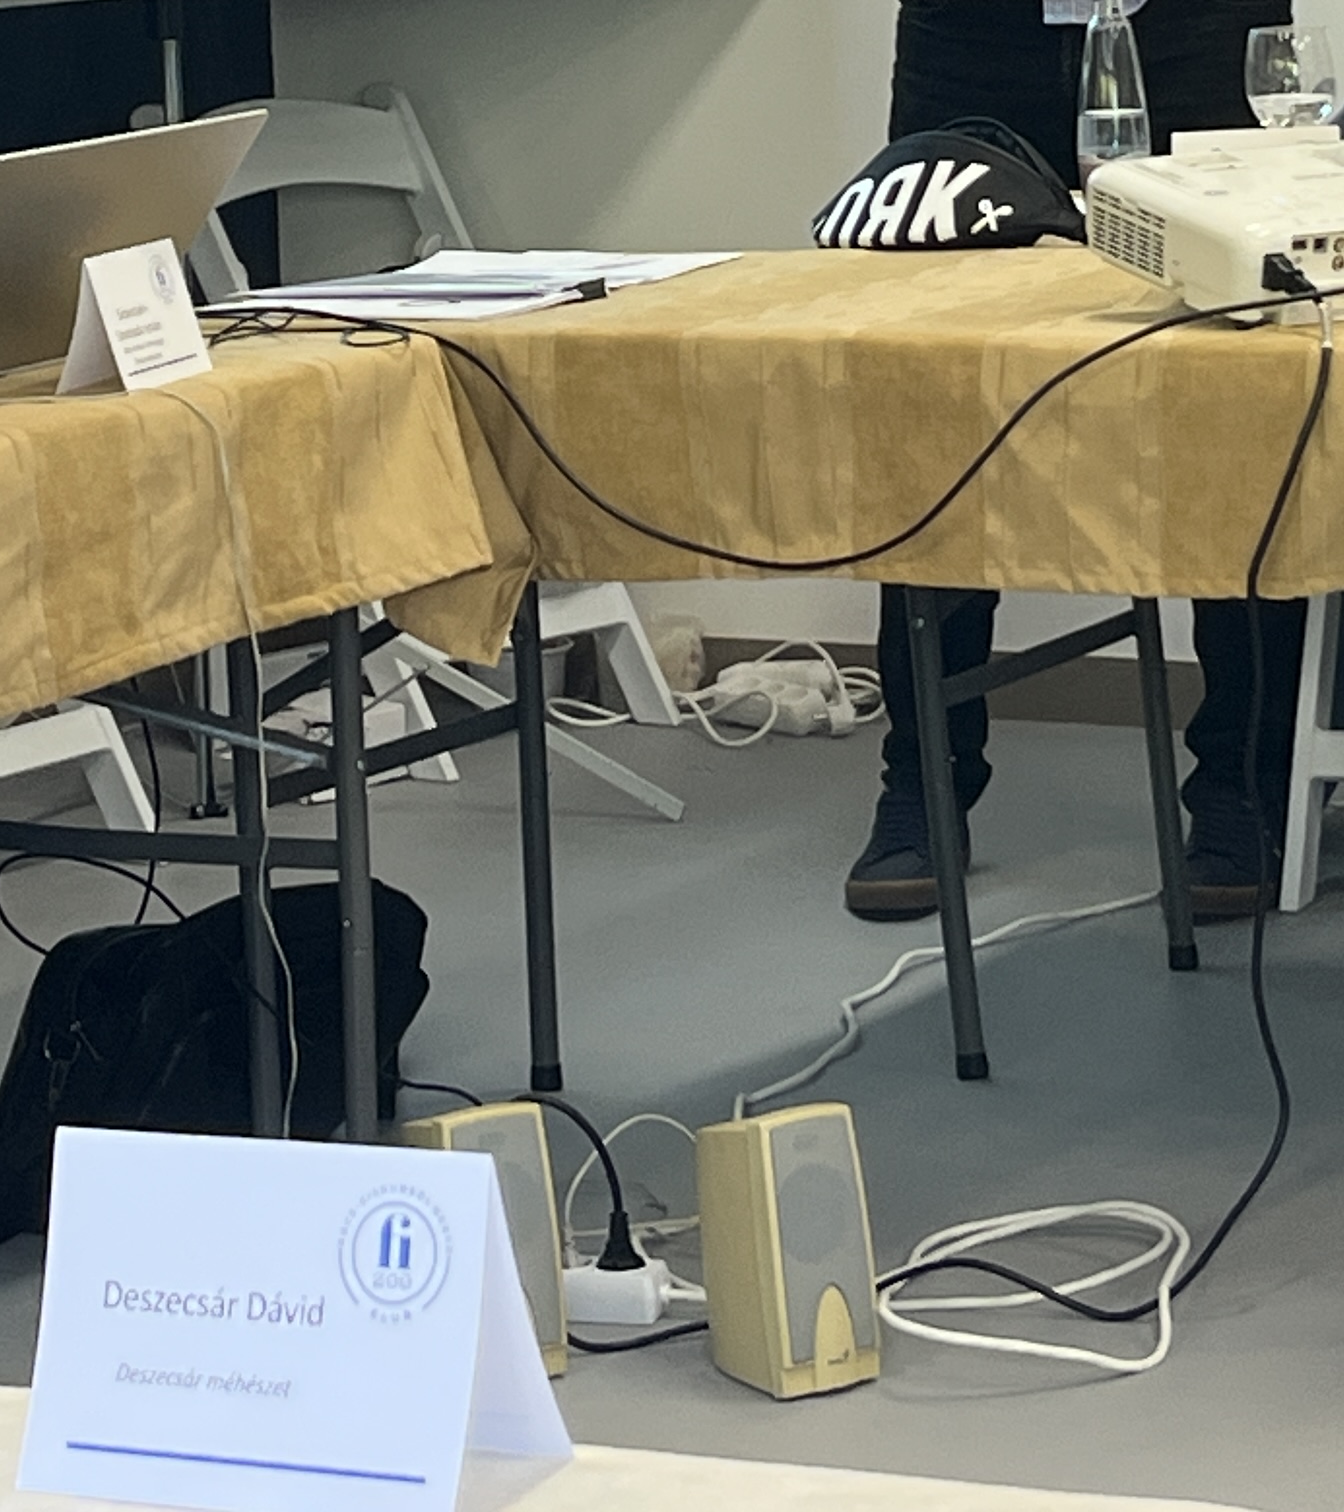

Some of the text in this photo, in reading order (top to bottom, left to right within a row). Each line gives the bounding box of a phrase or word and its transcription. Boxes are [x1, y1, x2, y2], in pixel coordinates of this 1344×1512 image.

[102, 1280, 326, 1328] Deszecsár Dávid
[115, 1362, 205, 1390] Deszecsár
